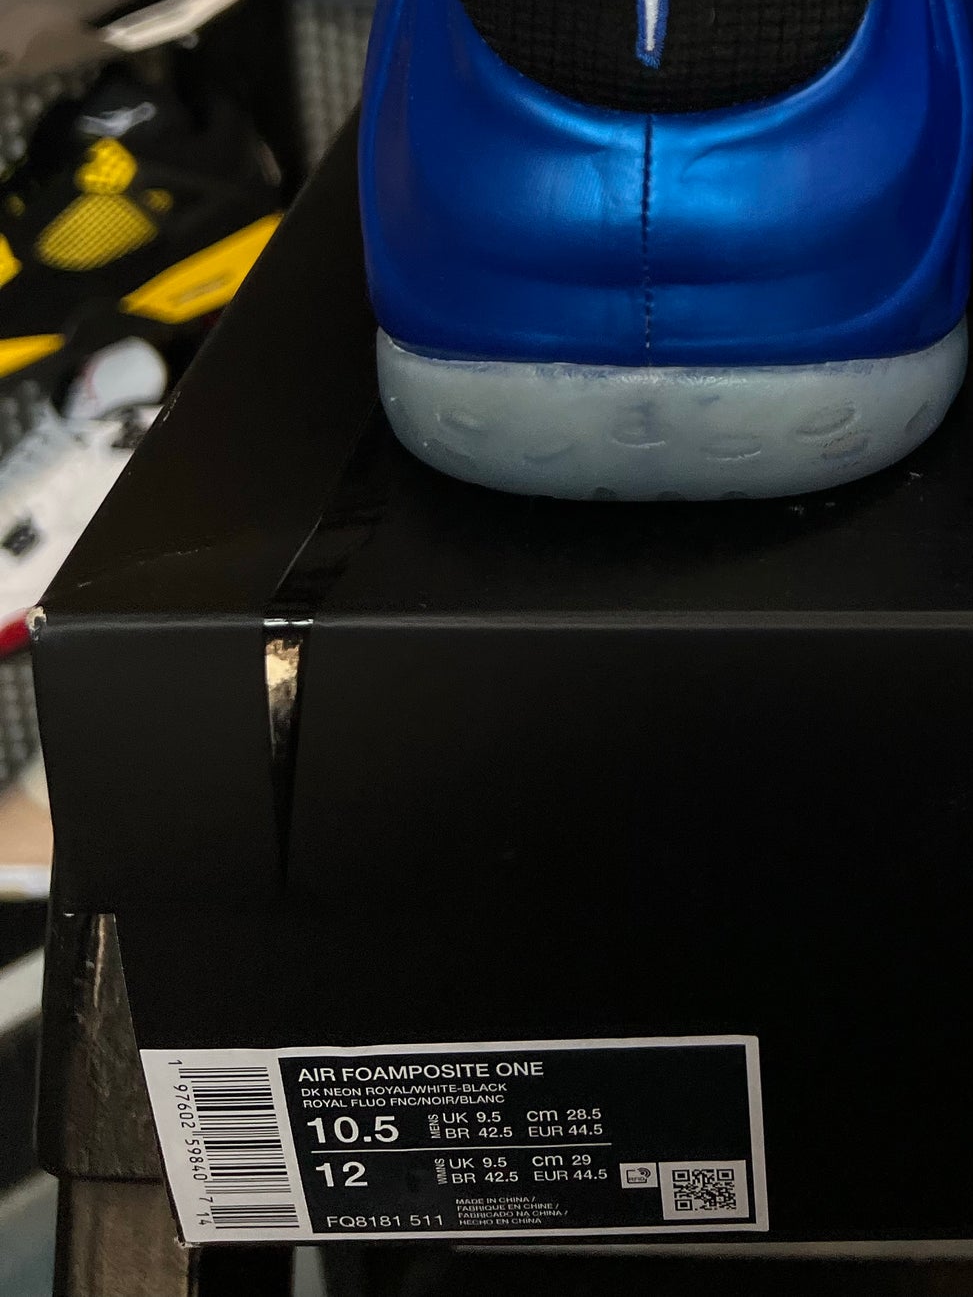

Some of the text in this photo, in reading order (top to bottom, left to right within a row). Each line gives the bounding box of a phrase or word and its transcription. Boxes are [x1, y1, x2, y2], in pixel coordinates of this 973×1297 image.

[298, 1061, 544, 1082] AIR FOAMPOSITE ONE
[301, 1083, 507, 1097] DK NEON ROYAL/WHITE-BLACK
[173, 1084, 196, 1128] 97602
[303, 1094, 505, 1108] ROYAL FLUO FNC/NOIR/BLANC
[442, 1111, 502, 1124] UK 9.5
[526, 1108, 602, 1122] cm 28.5
[307, 1115, 400, 1144] 10.5
[428, 1113, 442, 1139] MENS
[445, 1126, 513, 1139] BR 42.5
[528, 1123, 603, 1138] EUR 44.5
[184, 1139, 208, 1181] 59840
[449, 1156, 508, 1169] UK 9.5
[532, 1154, 592, 1167] cm 29
[315, 1161, 369, 1188] 12
[434, 1158, 448, 1186] WMNS
[452, 1171, 519, 1184] BR 42.5
[534, 1168, 608, 1182] EUR 44.5
[499, 1196, 530, 1204] CHINA
[457, 1204, 506, 1212] FABRIQUE
[458, 1211, 514, 1219] FABRICADO
[516, 1210, 531, 1218] NA
[196, 1212, 212, 1226] 14
[327, 1214, 444, 1228] FQ8181 511
[511, 1217, 542, 1225] CHINA
